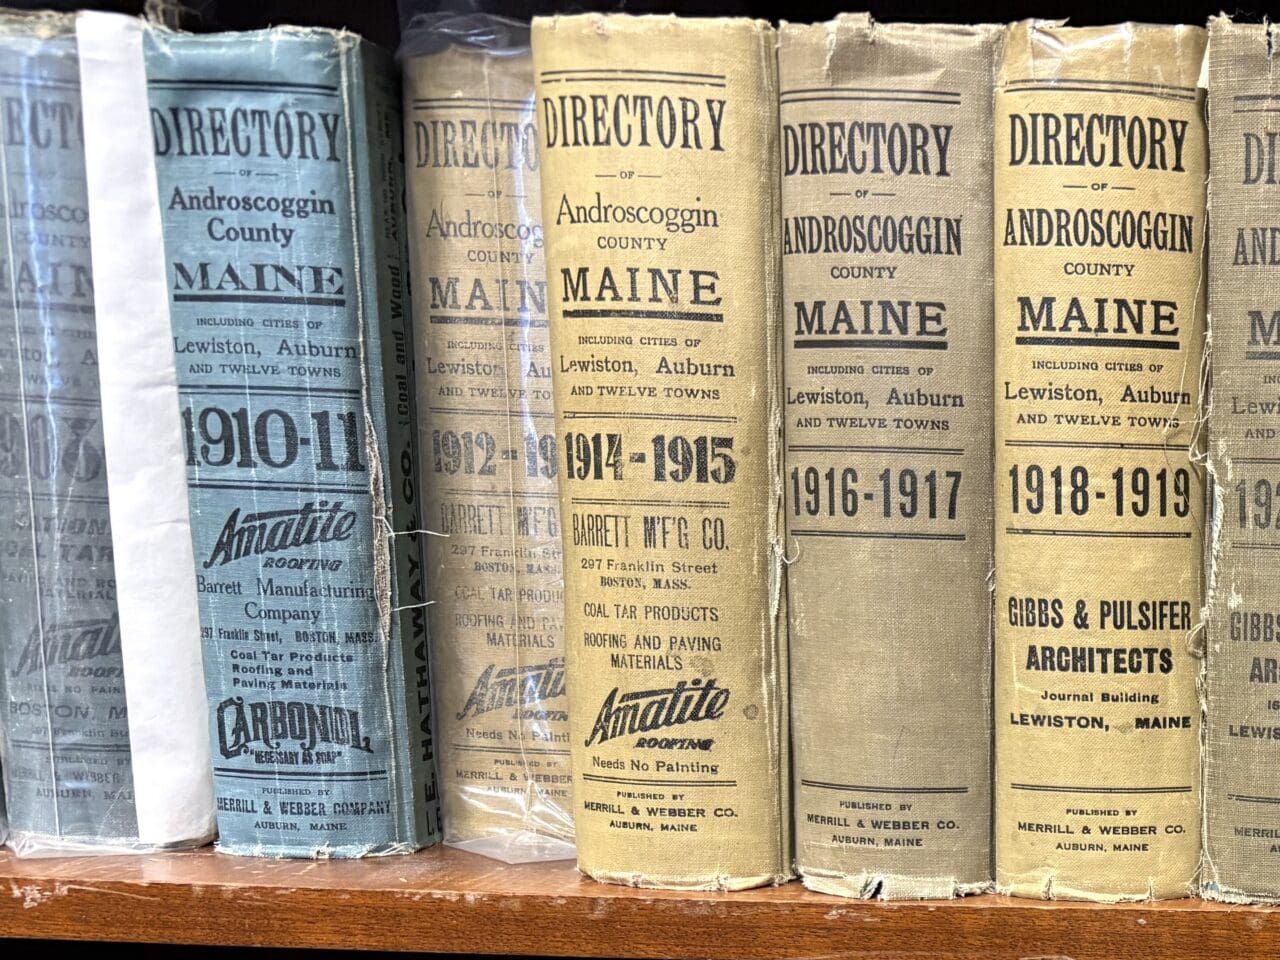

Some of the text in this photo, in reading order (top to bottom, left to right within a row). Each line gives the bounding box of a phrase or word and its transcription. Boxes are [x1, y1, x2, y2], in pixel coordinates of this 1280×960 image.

[152, 107, 341, 162] DIRECTORY
[542, 94, 726, 151] DIRECTORY
[783, 121, 953, 177] DIRECTORY
[1009, 113, 1189, 172] DIRECTORY
[168, 187, 336, 218] Androscoggin
[556, 192, 719, 233] Androscoggin
[207, 217, 294, 248] County
[783, 214, 963, 256] ANDROSCOGGIN
[173, 263, 345, 295] MAINE
[196, 318, 323, 330] INCLUDING CITIES OF
[174, 336, 357, 359] Lewiston, Auburn
[571, 386, 720, 400] AND TWELVE TOWNS
[791, 467, 962, 519] 1916-1917
[1009, 465, 1190, 518] 1918-1919
[203, 500, 356, 569] Amatite
[572, 513, 630, 547] BARRETT
[702, 517, 729, 550] CO.
[581, 558, 718, 574] 297 Franklin Street
[244, 602, 321, 625] Company
[584, 602, 719, 622] COAL TAR PRODUCTS
[1008, 596, 1191, 630] GIBBS & PULSIFER
[487, 633, 555, 648] MATERIALS
[408, 554, 434, 760] HATHAWAY
[1041, 691, 1159, 704] Journal Building
[1010, 713, 1191, 731] LEWISTON, MAINE
[840, 801, 892, 811] PUBLISHED
[254, 821, 347, 832] AUBURN, MAINE
[832, 834, 922, 846] AUBURN, MAINE
